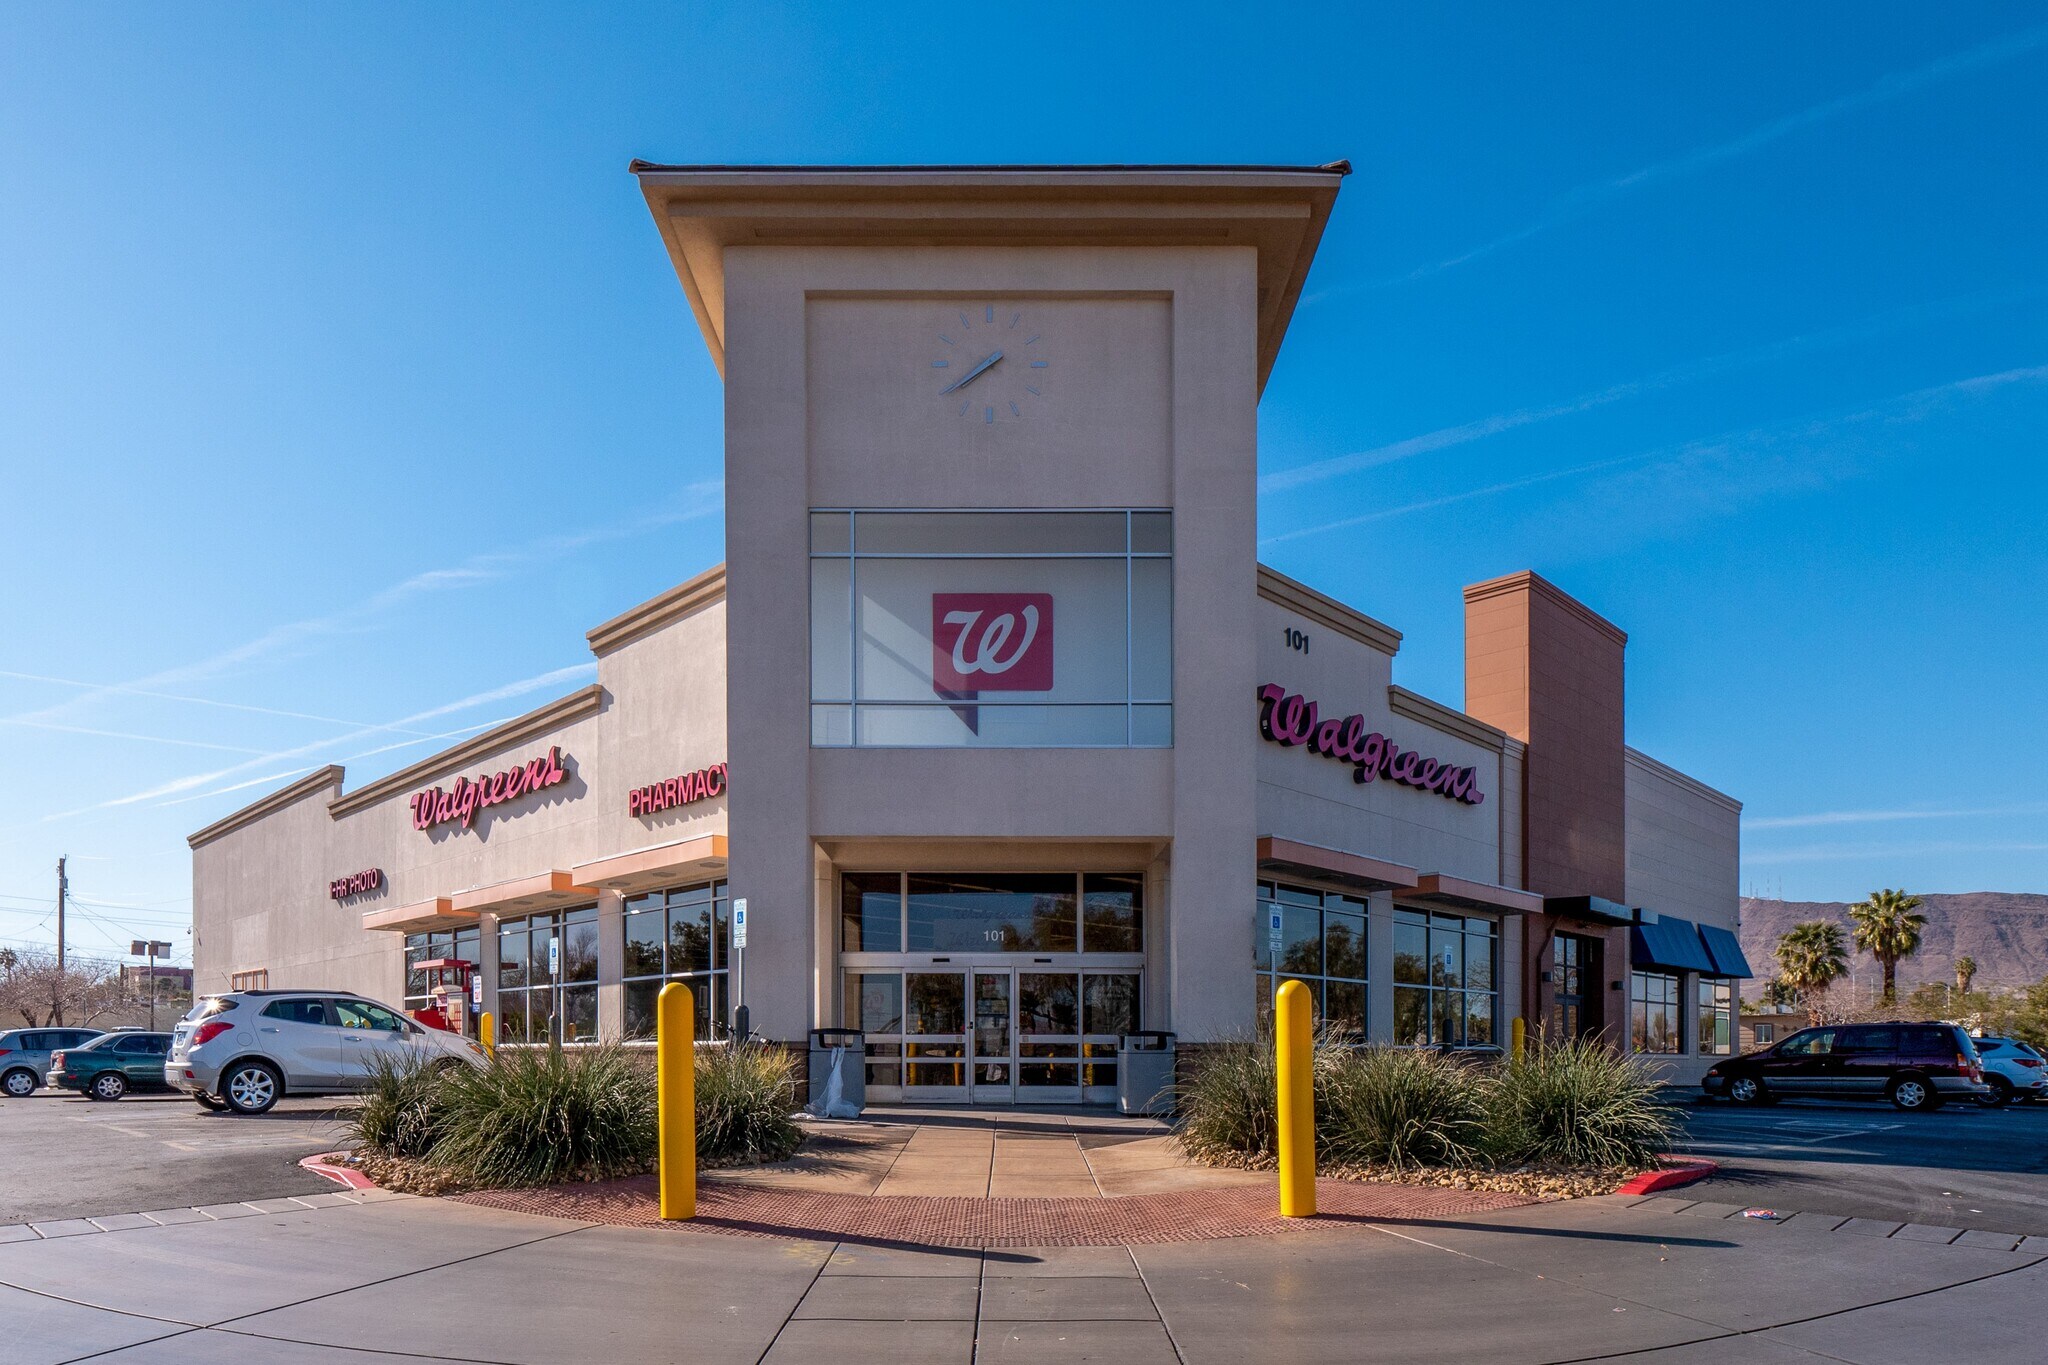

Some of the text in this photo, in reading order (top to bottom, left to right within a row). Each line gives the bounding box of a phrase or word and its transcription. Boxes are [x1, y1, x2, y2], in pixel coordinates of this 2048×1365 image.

[943, 604, 1039, 675] W
[1284, 627, 1309, 654] 101
[1258, 683, 1485, 804] Walgreens
[410, 745, 567, 831] Walgreens
[349, 868, 380, 895] PHOTO
[984, 930, 1005, 942] 101
